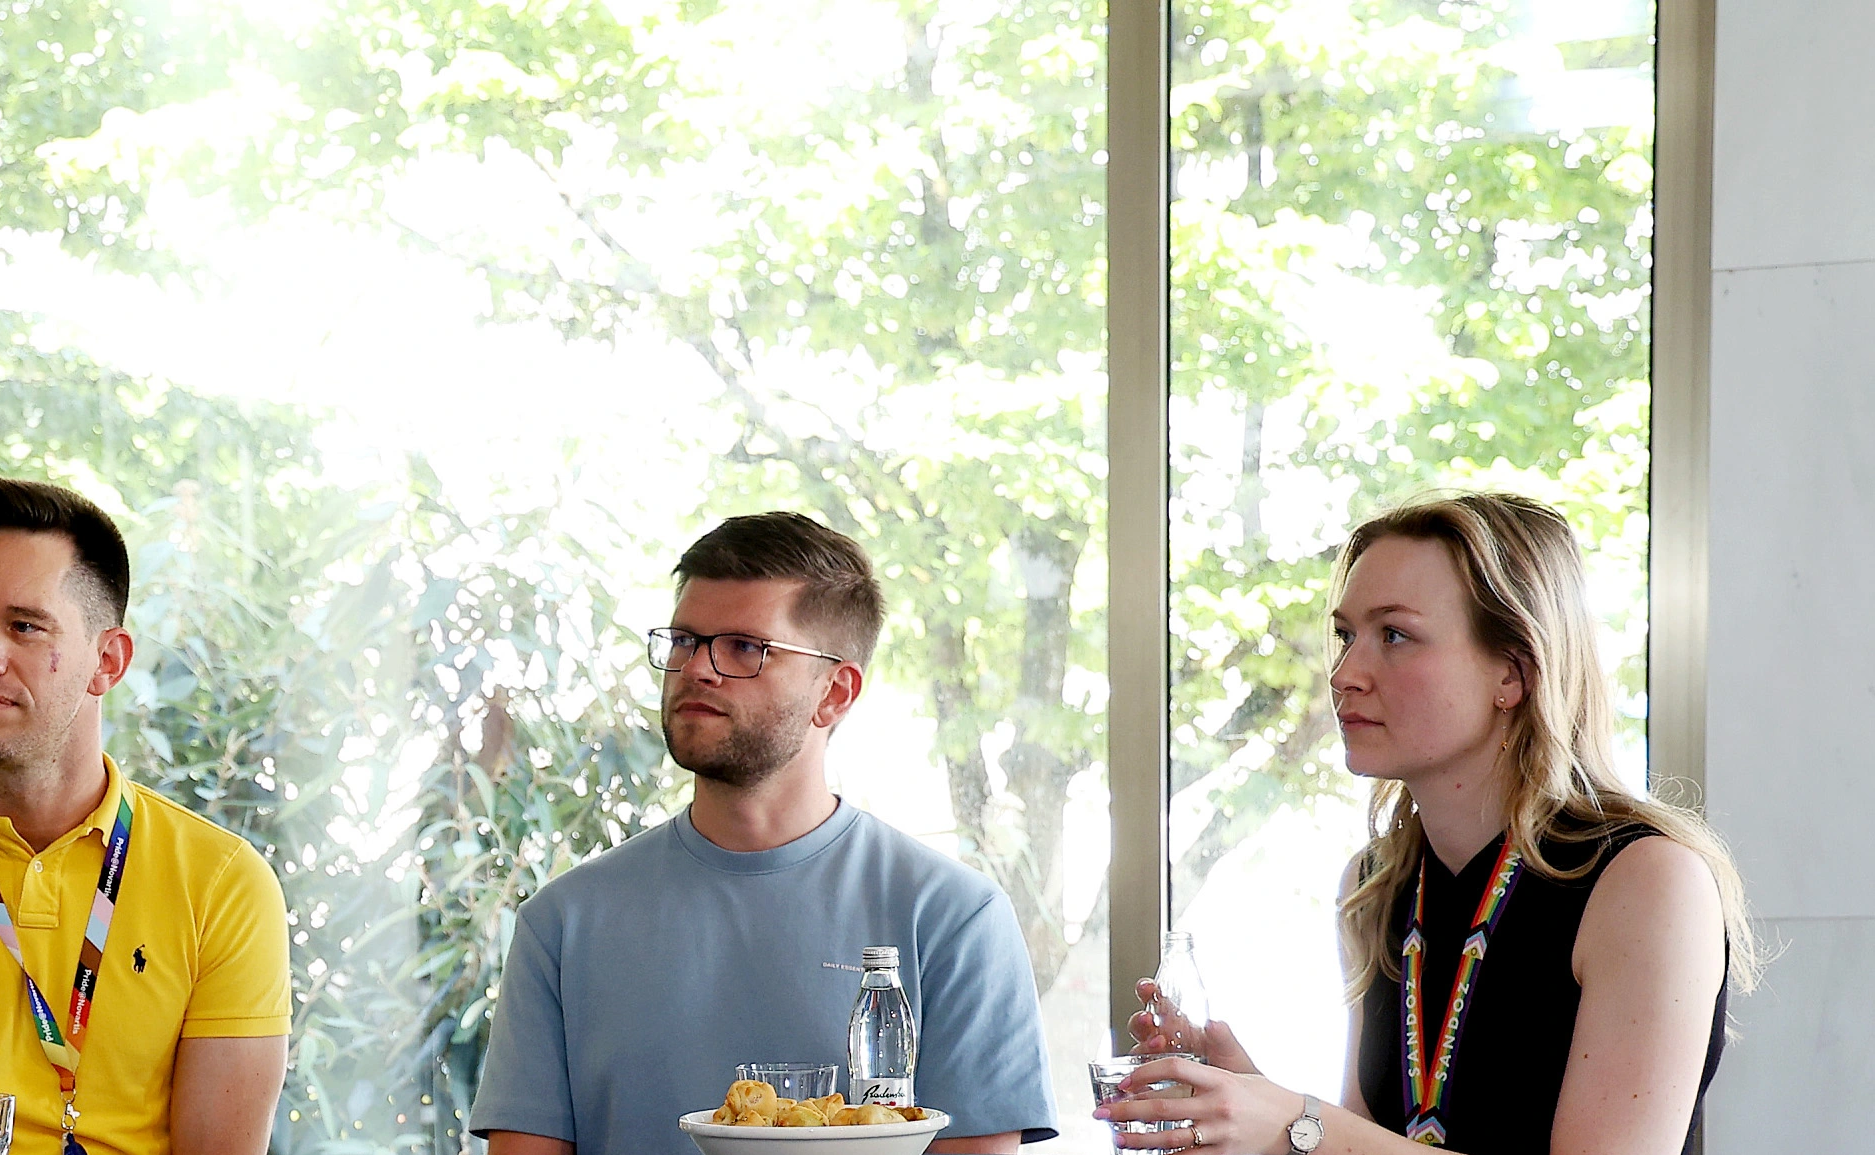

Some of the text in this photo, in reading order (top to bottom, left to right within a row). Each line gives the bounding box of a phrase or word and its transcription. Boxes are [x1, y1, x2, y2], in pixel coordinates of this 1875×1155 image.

[71, 968, 93, 1035] Pride@Novartis
[1405, 978, 1421, 1078] SANDOZ
[1434, 982, 1470, 1082] SANDOZ
